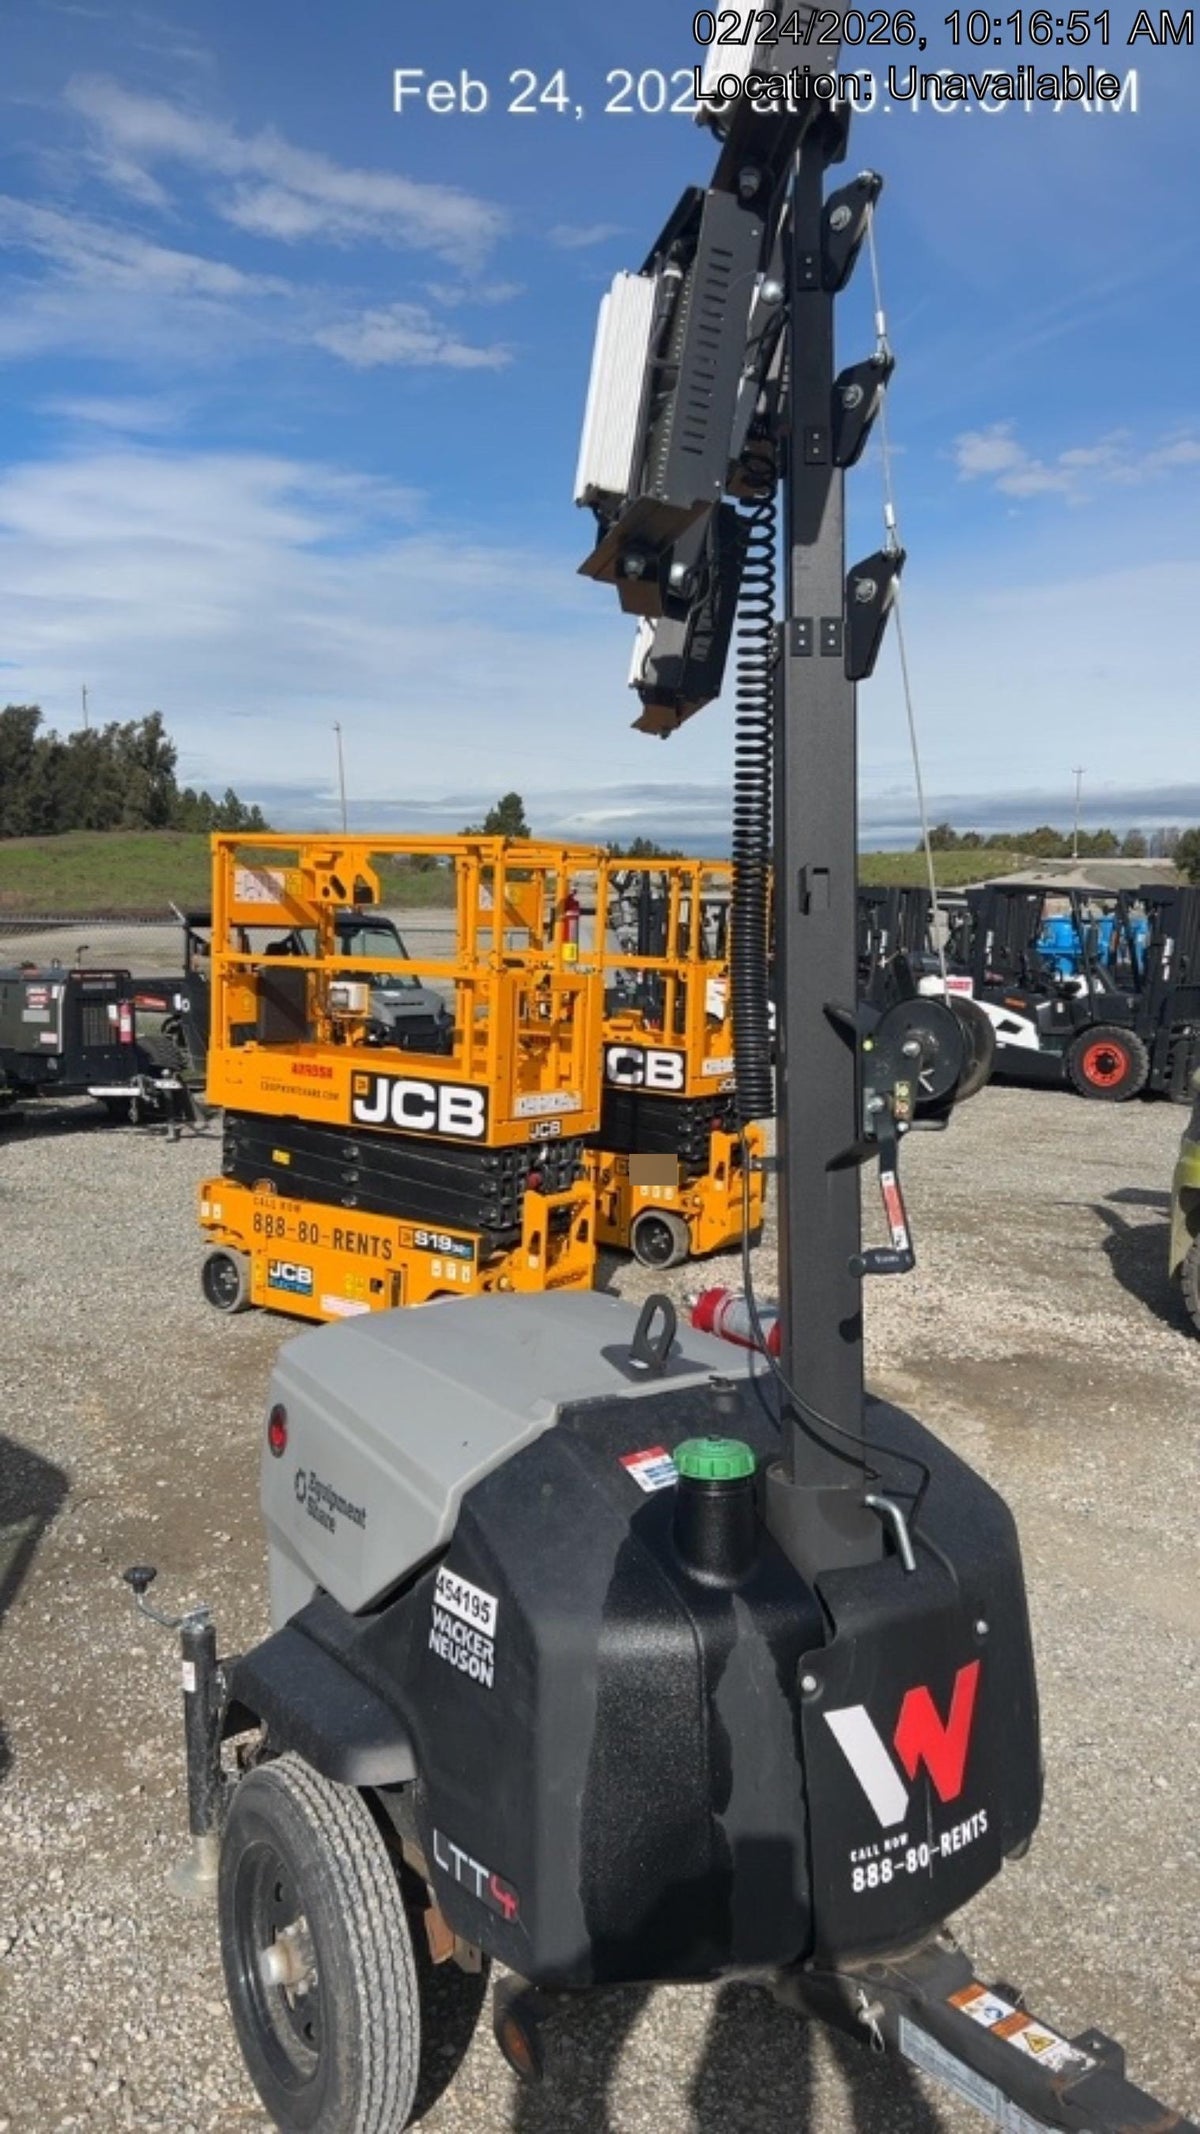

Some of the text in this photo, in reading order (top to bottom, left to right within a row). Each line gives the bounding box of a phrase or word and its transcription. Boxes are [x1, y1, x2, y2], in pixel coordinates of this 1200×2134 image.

[607, 1046, 684, 1090] CB
[353, 1077, 486, 1137] JCB
[529, 1121, 561, 1140] JCB
[253, 1211, 393, 1260] 888-80-RENTS
[270, 1260, 312, 1284] JCB
[307, 1494, 336, 1535] Share
[308, 1471, 367, 1530] Equipment
[436, 1572, 491, 1625] 454195
[428, 1628, 494, 1689] NEUSON
[432, 1604, 495, 1666] WACKER
[433, 1827, 518, 1920] LTT4
[850, 1832, 910, 1863] CALL NOW
[852, 1808, 989, 1893] 888-80-RENTS
